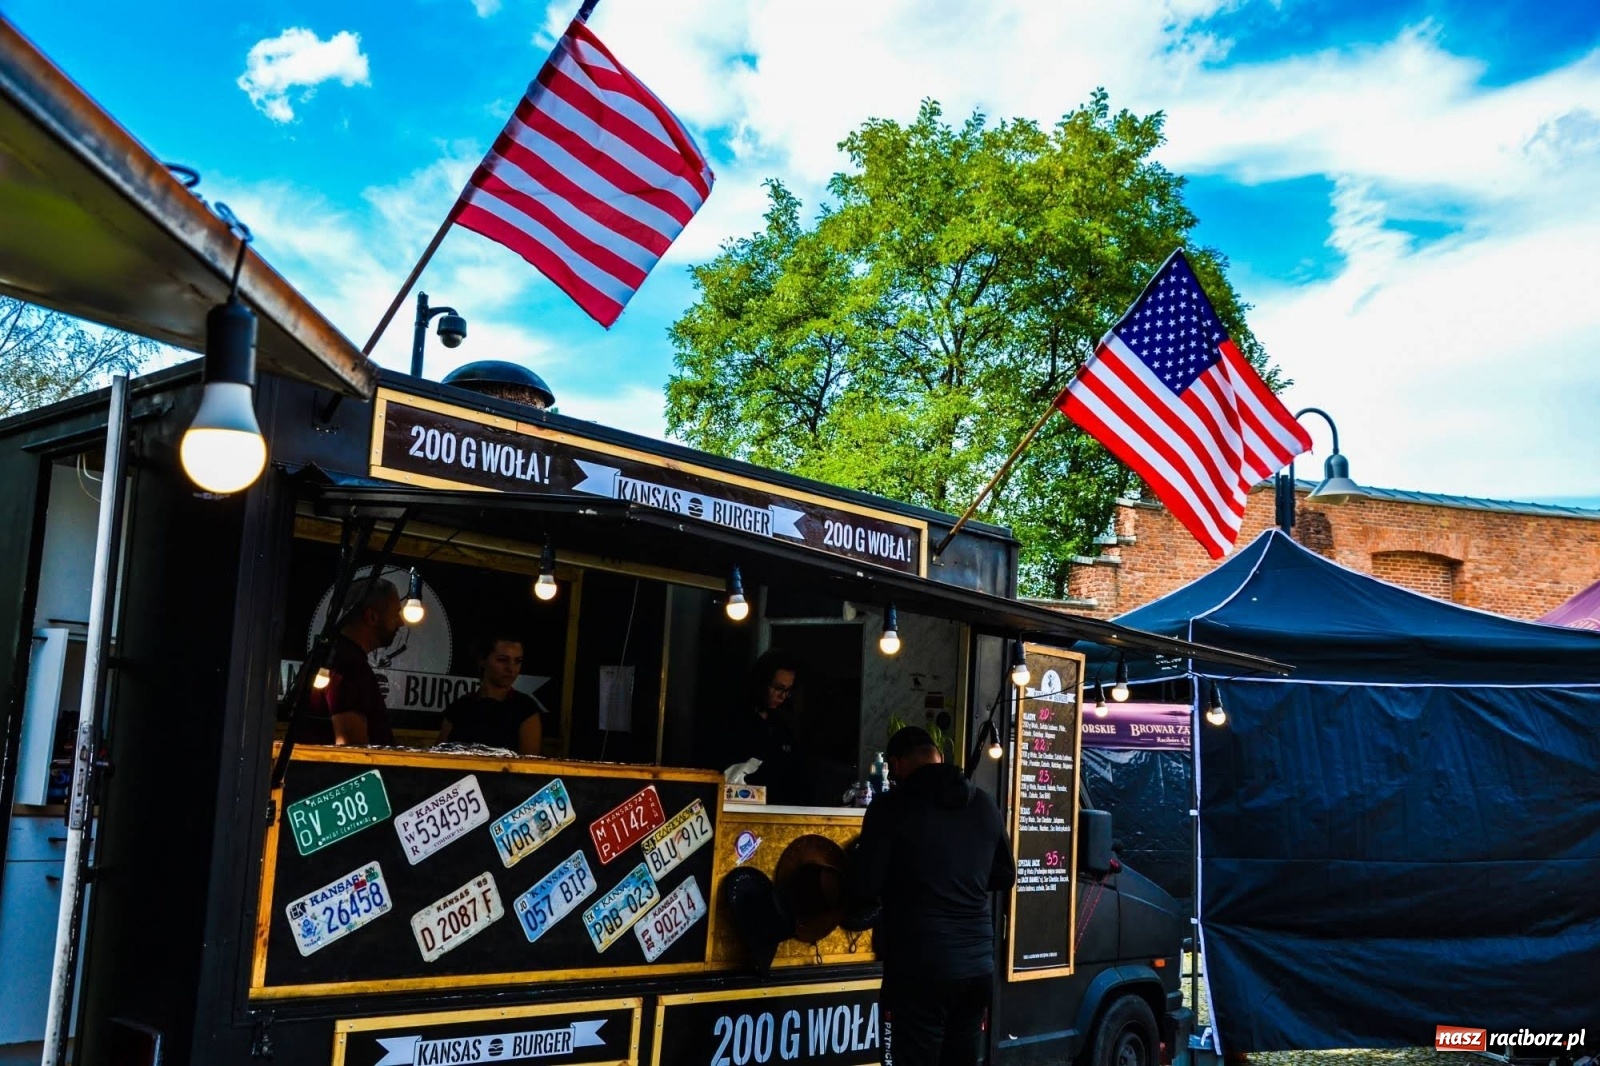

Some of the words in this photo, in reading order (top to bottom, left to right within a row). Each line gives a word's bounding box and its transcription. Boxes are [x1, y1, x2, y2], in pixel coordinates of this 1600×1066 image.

[409, 425, 457, 465] 200
[461, 437, 477, 469] G
[618, 479, 681, 514] KANSAS
[713, 501, 770, 535] BURGER
[823, 519, 852, 550] 200
[855, 529, 865, 552] G
[1130, 723, 1176, 736] BROWAR
[310, 786, 347, 807] KANSAS
[348, 780, 361, 790] 75
[415, 788, 459, 819] KANSAS
[511, 797, 544, 822] KANSAS
[308, 809, 322, 836] V
[331, 791, 369, 826] 308
[415, 789, 481, 845] 534595
[606, 803, 633, 824] KANSAS
[611, 805, 649, 843] 1142
[501, 823, 536, 857] VOR
[650, 838, 678, 873] BLU
[682, 815, 708, 847] 912
[308, 874, 361, 906] KANSAS
[530, 865, 570, 899] KANSAS
[601, 881, 631, 908] KANSAS
[322, 882, 384, 934] 26458
[436, 888, 471, 913] KANSAS
[524, 893, 554, 932] 057
[559, 867, 587, 904] BIP
[593, 907, 623, 944] PQB
[627, 879, 654, 914] 023
[652, 892, 679, 918] KANSAS
[420, 927, 436, 952] D
[437, 897, 478, 942] 2087
[481, 888, 491, 913] F
[416, 1038, 482, 1066] KANSAS
[512, 1031, 572, 1058] BURGER
[711, 1011, 775, 1066] 200
[780, 1009, 801, 1061] G
[808, 1002, 880, 1057] WOŁA
